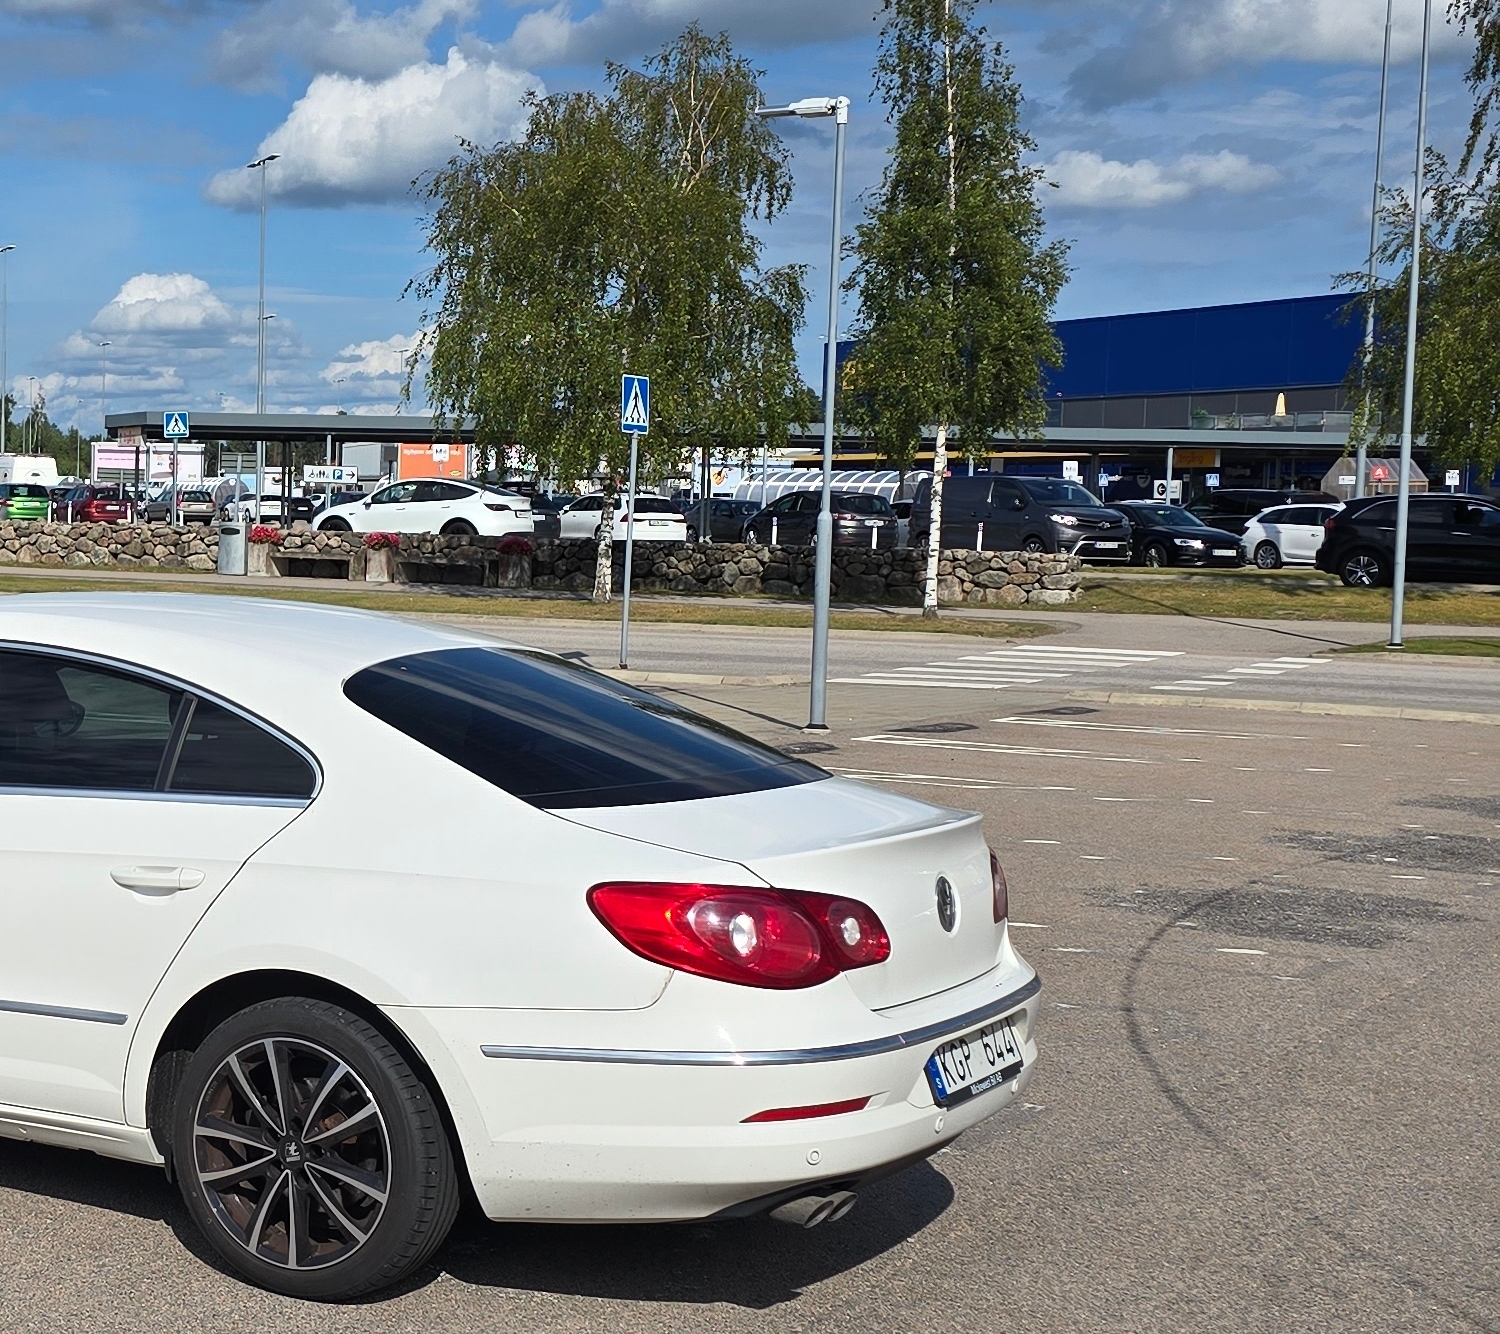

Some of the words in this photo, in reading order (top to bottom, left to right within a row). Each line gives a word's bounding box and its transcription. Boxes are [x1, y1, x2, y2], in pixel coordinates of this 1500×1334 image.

[936, 1038, 973, 1088] KGP
[980, 1019, 1016, 1067] 644
[935, 1077, 943, 1089] S
